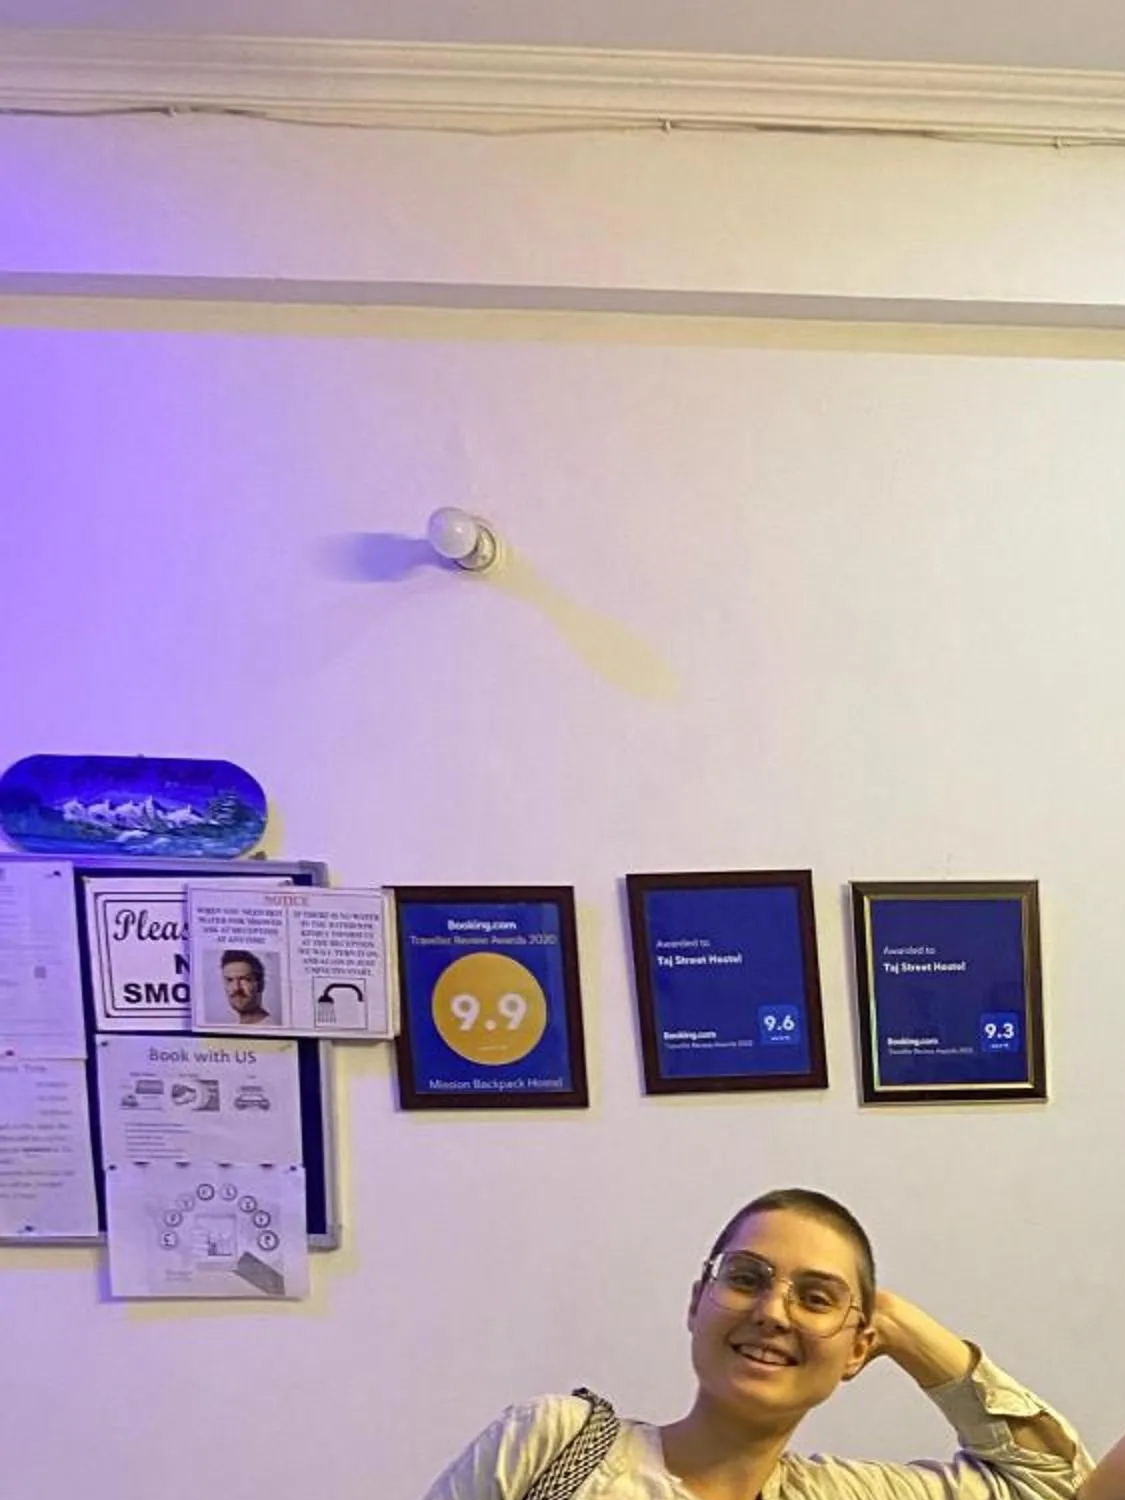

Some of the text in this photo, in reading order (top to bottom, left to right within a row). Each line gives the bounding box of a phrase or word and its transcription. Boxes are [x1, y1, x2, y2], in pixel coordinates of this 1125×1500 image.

[113, 908, 190, 941] Pleas
[447, 919, 518, 932] Booking.com
[173, 952, 190, 975] N
[656, 953, 742, 967] Taj Street Hostel
[883, 961, 966, 975] Taj Street Hostel
[451, 993, 528, 1031] 9.9
[763, 1015, 796, 1032] 9.6
[984, 1023, 1015, 1039] 9.3
[149, 1048, 257, 1064] Book with US
[473, 1079, 525, 1091] Backpack
